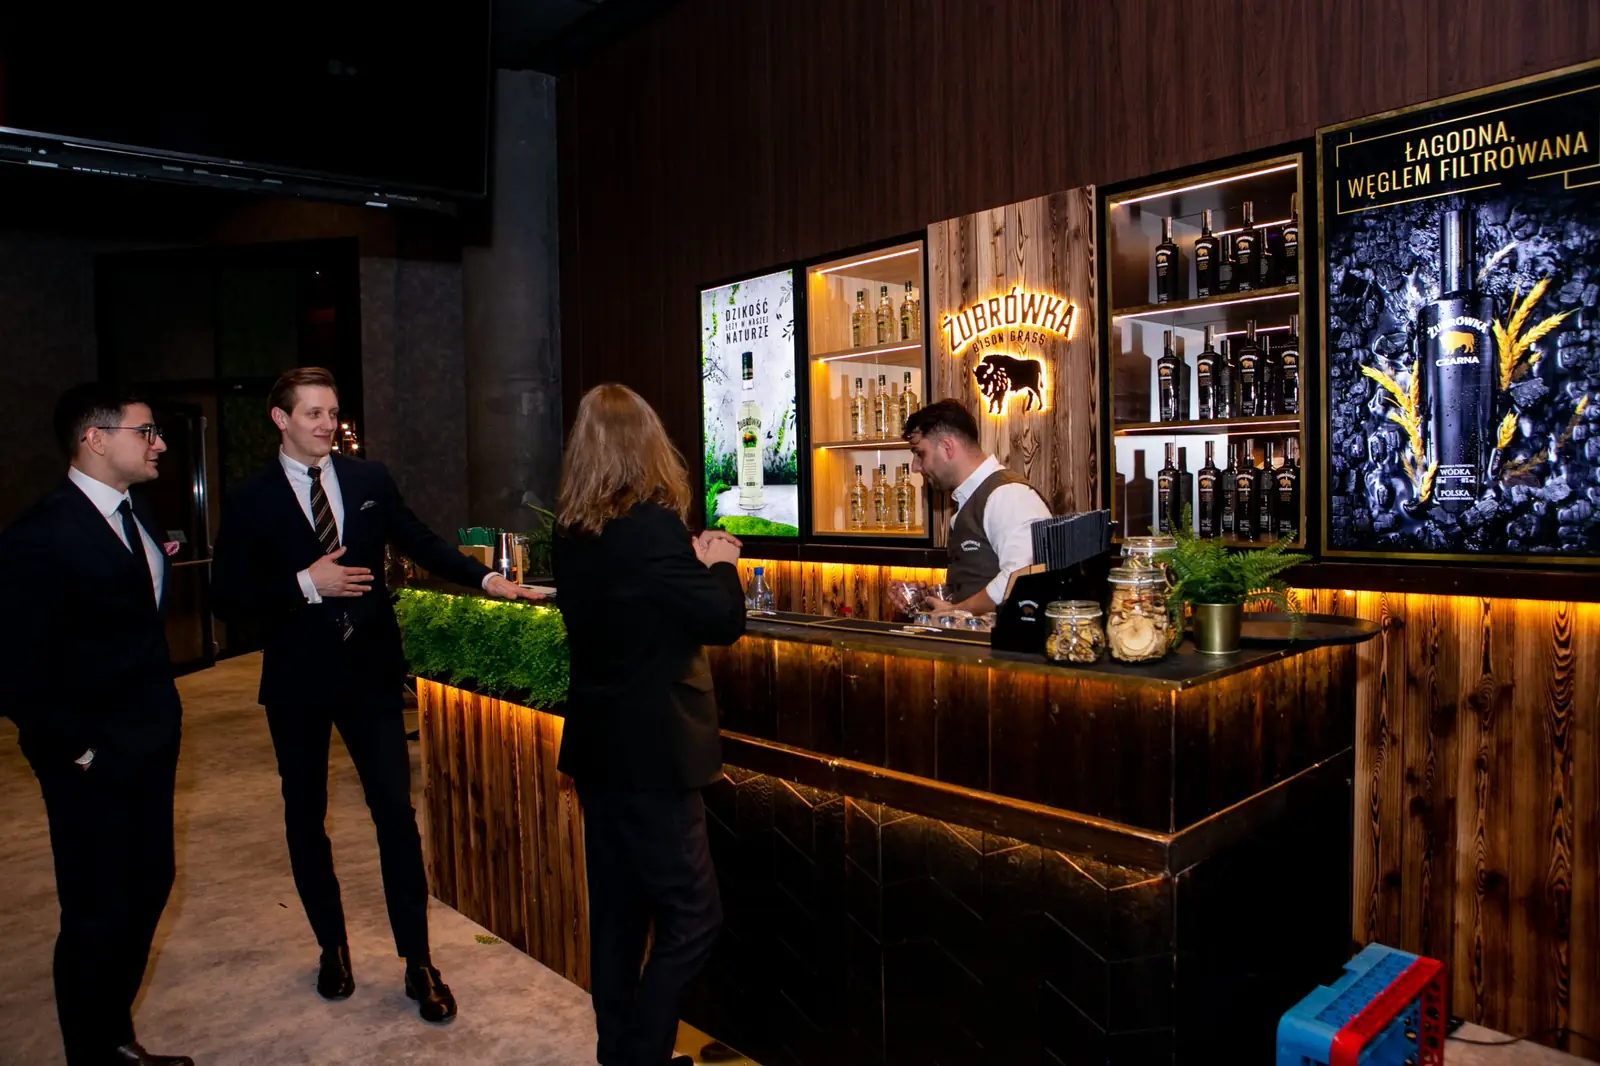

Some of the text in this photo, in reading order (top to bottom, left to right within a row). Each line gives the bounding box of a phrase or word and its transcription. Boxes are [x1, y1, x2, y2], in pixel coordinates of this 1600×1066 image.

[1404, 121, 1516, 162] ŁAGODNA,
[1347, 131, 1589, 199] WĘGLEM FILTROWANA
[725, 298, 769, 322] DZIKOŚĆ
[942, 286, 1076, 352] ŻUBRÓWKA
[726, 325, 769, 344] NATURZE
[972, 330, 1046, 353] BISON GRASS
[1439, 468, 1471, 476] WÓDKA
[1440, 489, 1470, 497] POLSKA
